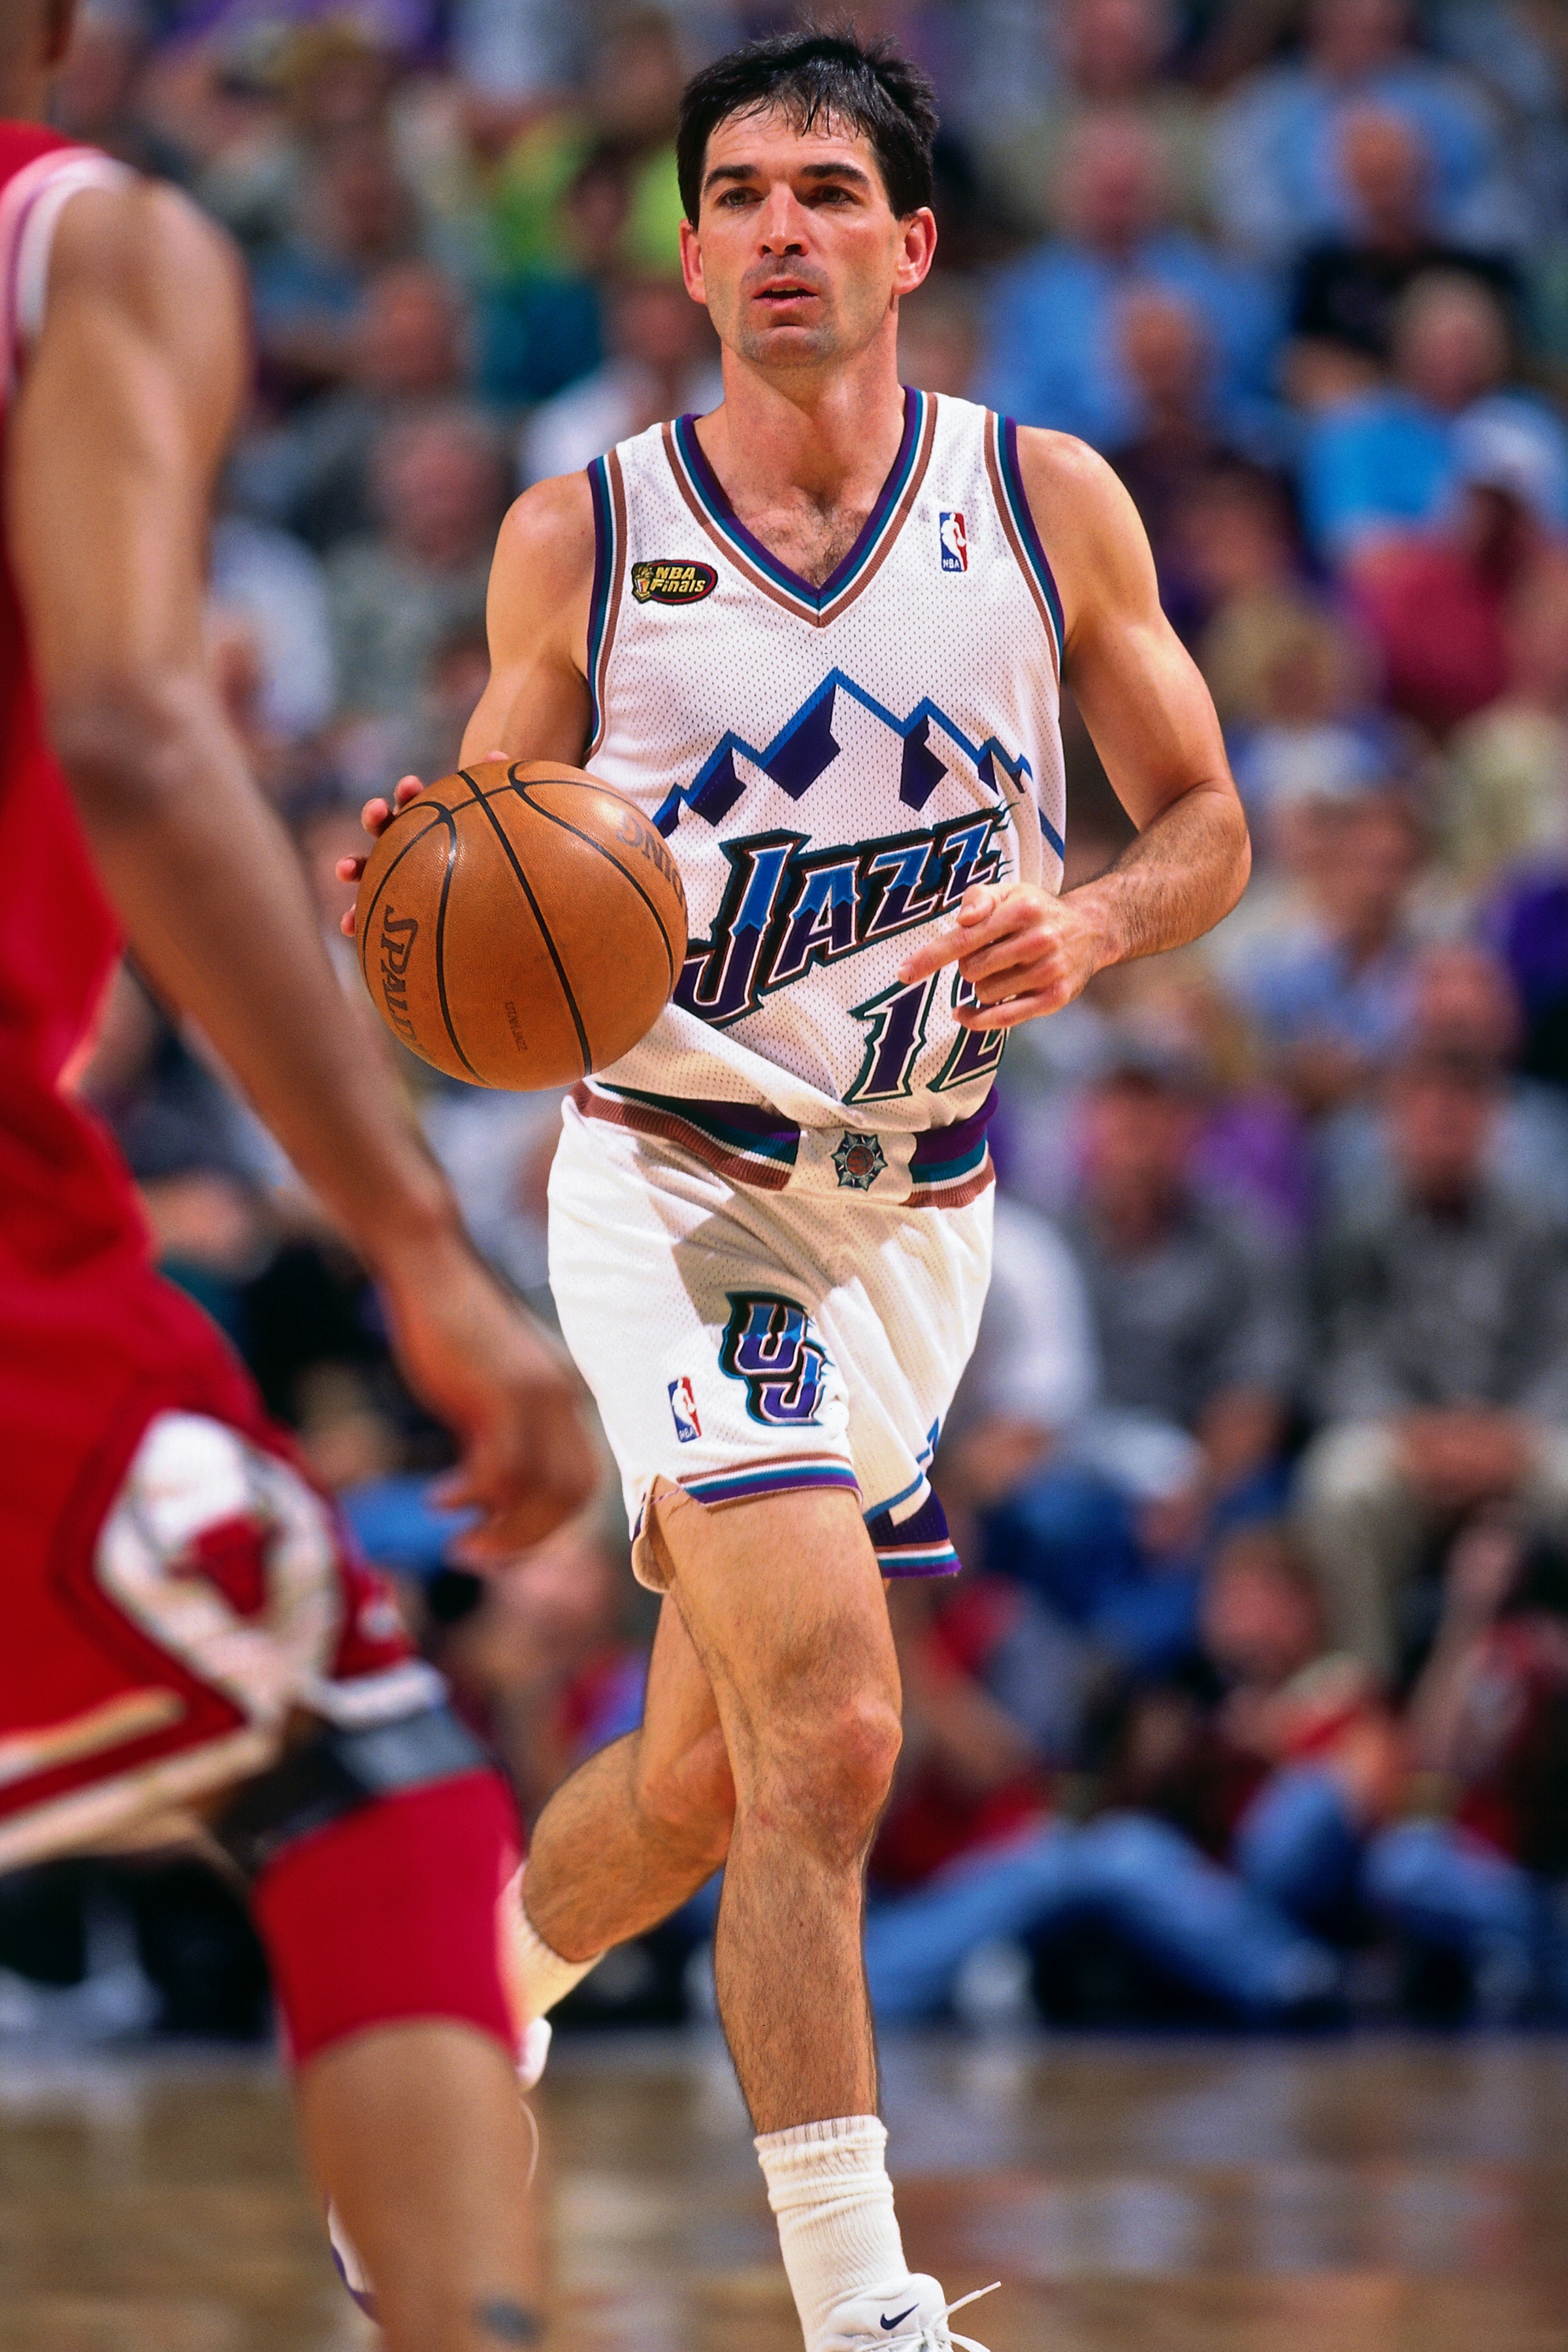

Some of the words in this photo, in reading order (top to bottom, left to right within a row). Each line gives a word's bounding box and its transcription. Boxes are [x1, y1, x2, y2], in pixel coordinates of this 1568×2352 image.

[943, 559, 960, 568] NBA
[655, 566, 696, 580] NBA
[649, 579, 706, 593] Finals
[617, 809, 685, 909] DING
[381, 904, 420, 1047] SPALD
[679, 1426, 694, 1441] NBA
